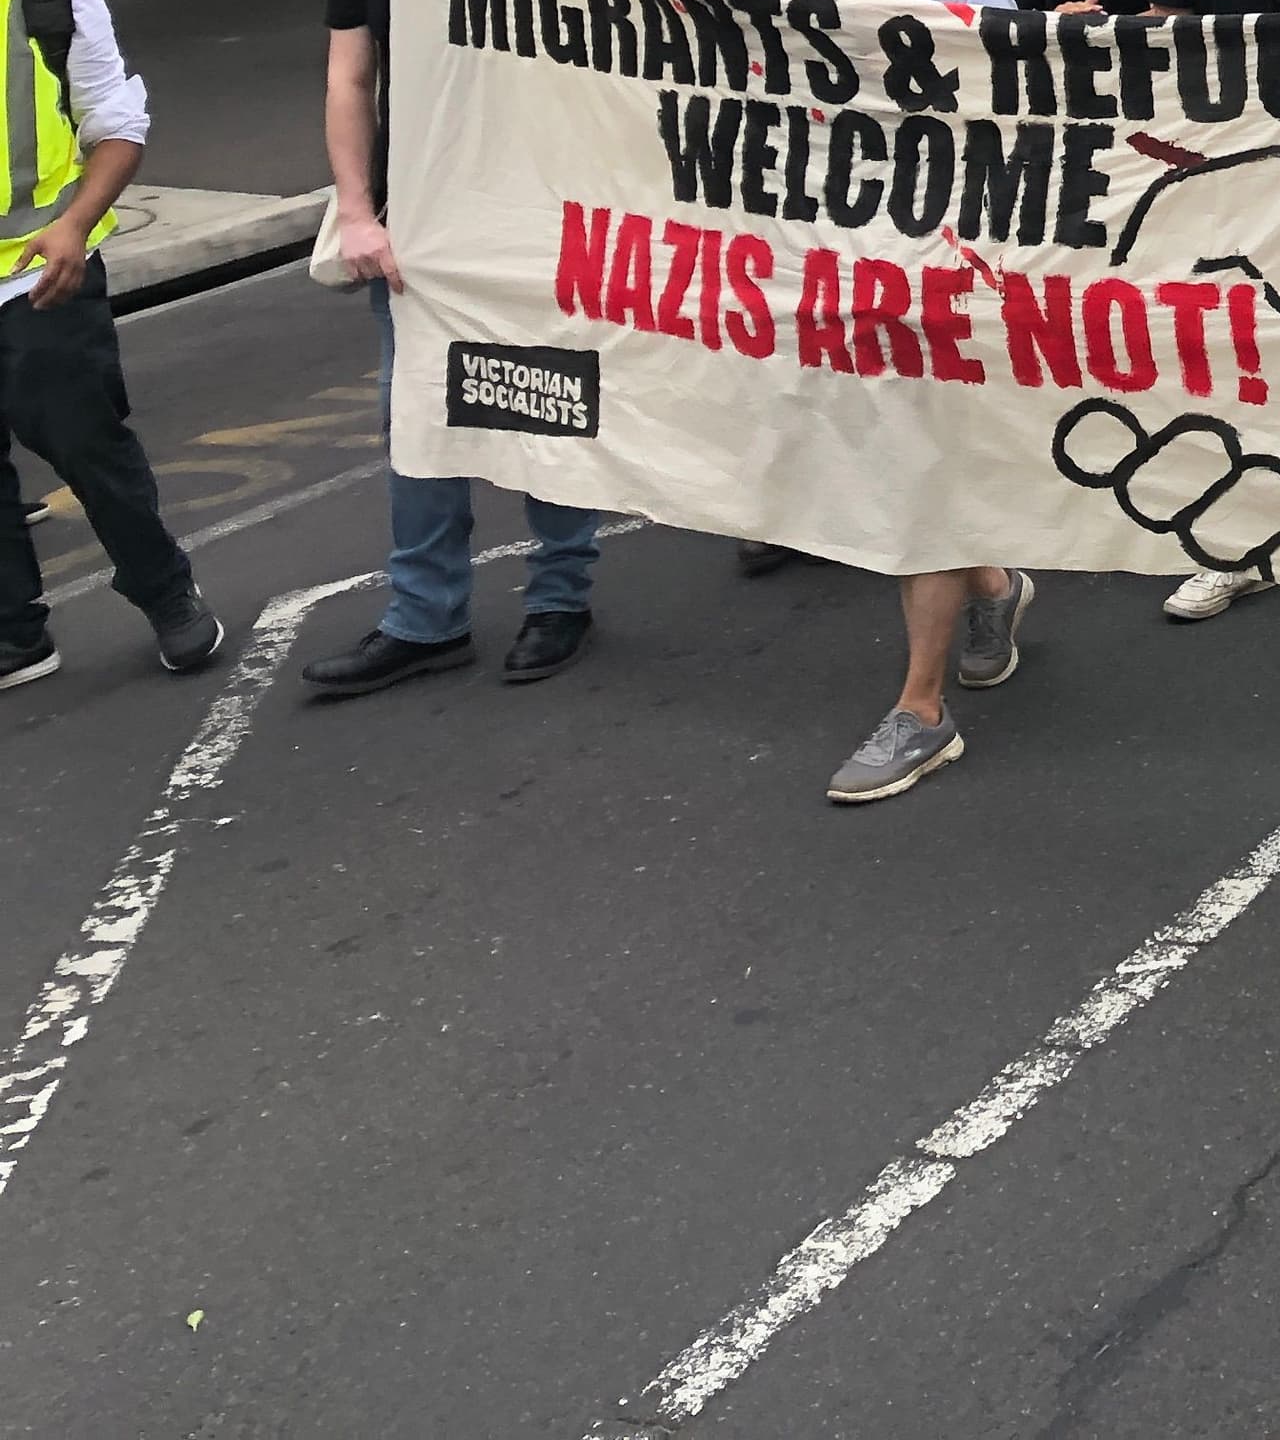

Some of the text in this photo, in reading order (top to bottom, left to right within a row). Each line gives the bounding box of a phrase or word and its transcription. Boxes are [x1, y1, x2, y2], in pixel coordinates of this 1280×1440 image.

[878, 14, 960, 113] &
[657, 89, 1115, 248] WELCOME
[553, 200, 1269, 406] NAZIS ARE NOT!
[460, 352, 583, 402] VICTORIAN
[460, 377, 589, 430] SOCIALISTS
